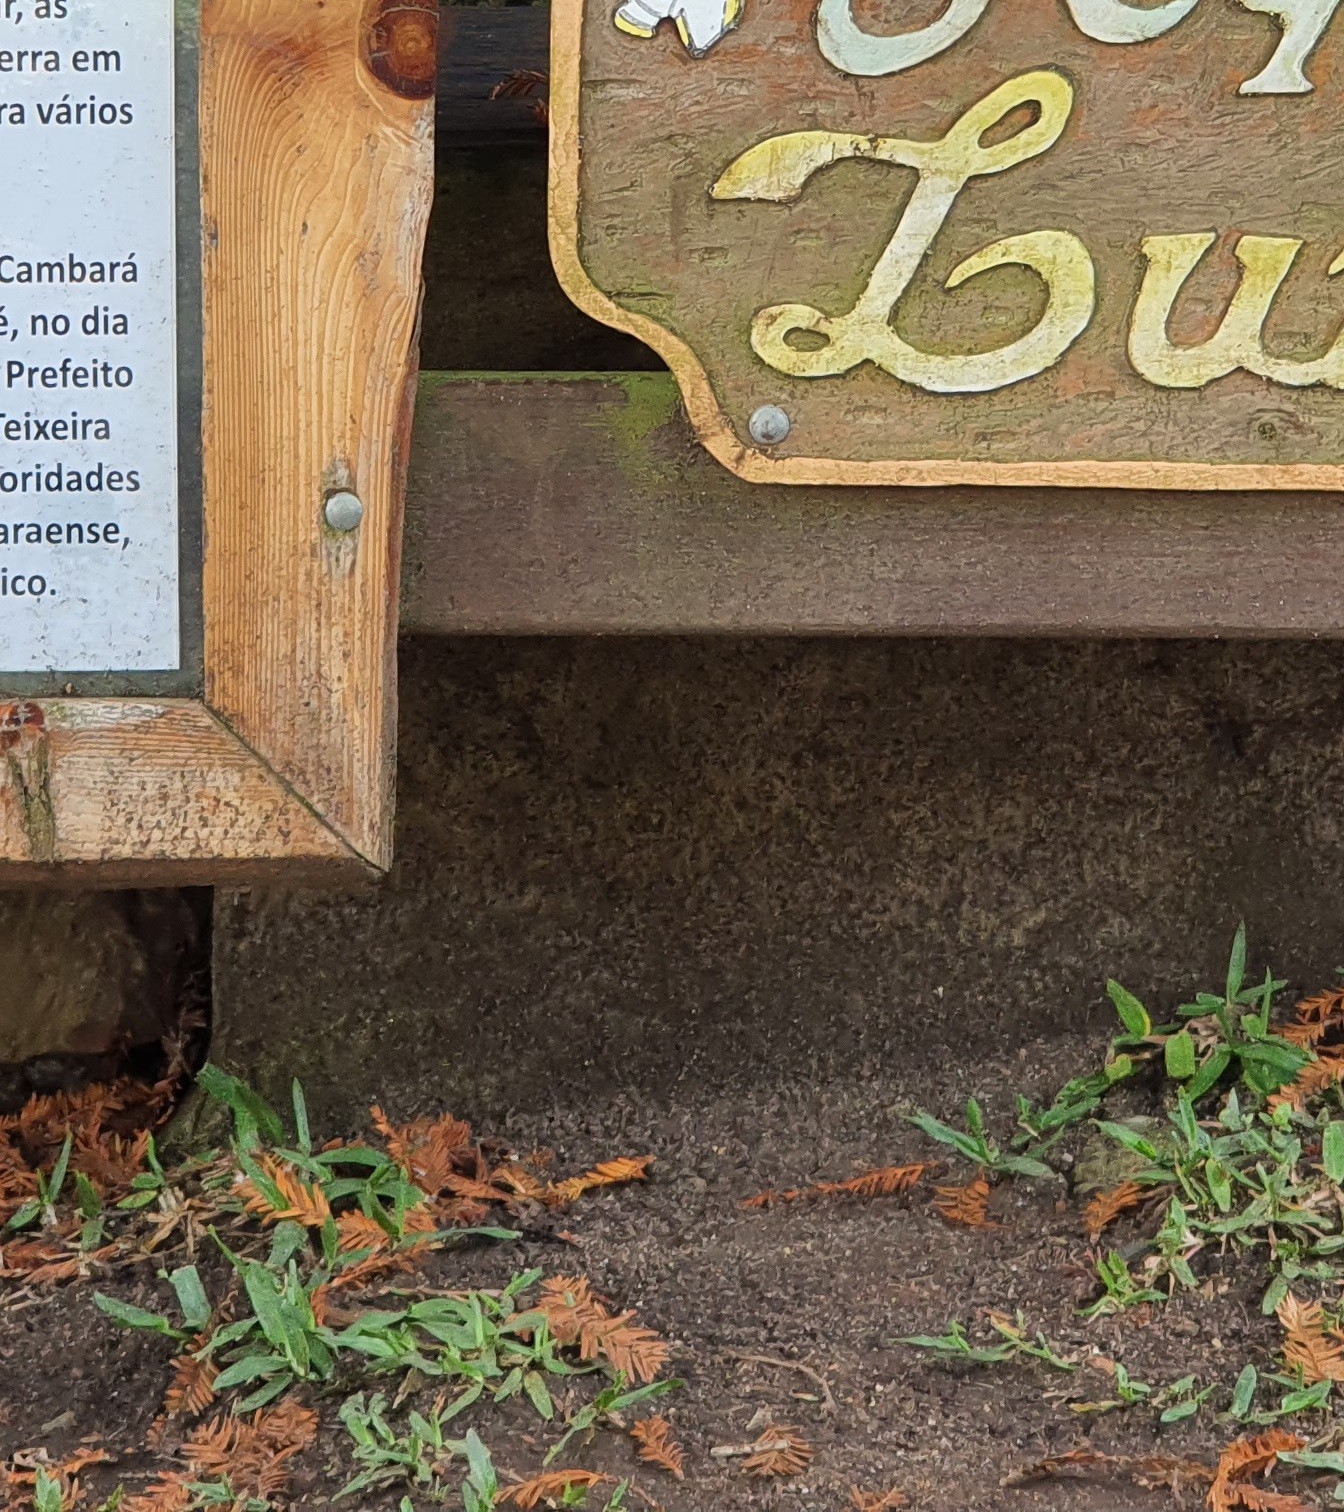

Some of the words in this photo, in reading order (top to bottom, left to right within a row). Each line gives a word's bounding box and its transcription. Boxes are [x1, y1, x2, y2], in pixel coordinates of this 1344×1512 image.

[71, 50, 121, 72] em
[35, 93, 133, 125] vários
[30, 314, 71, 336] no
[81, 305, 129, 336] dia
[6, 357, 134, 389] Prefeito
